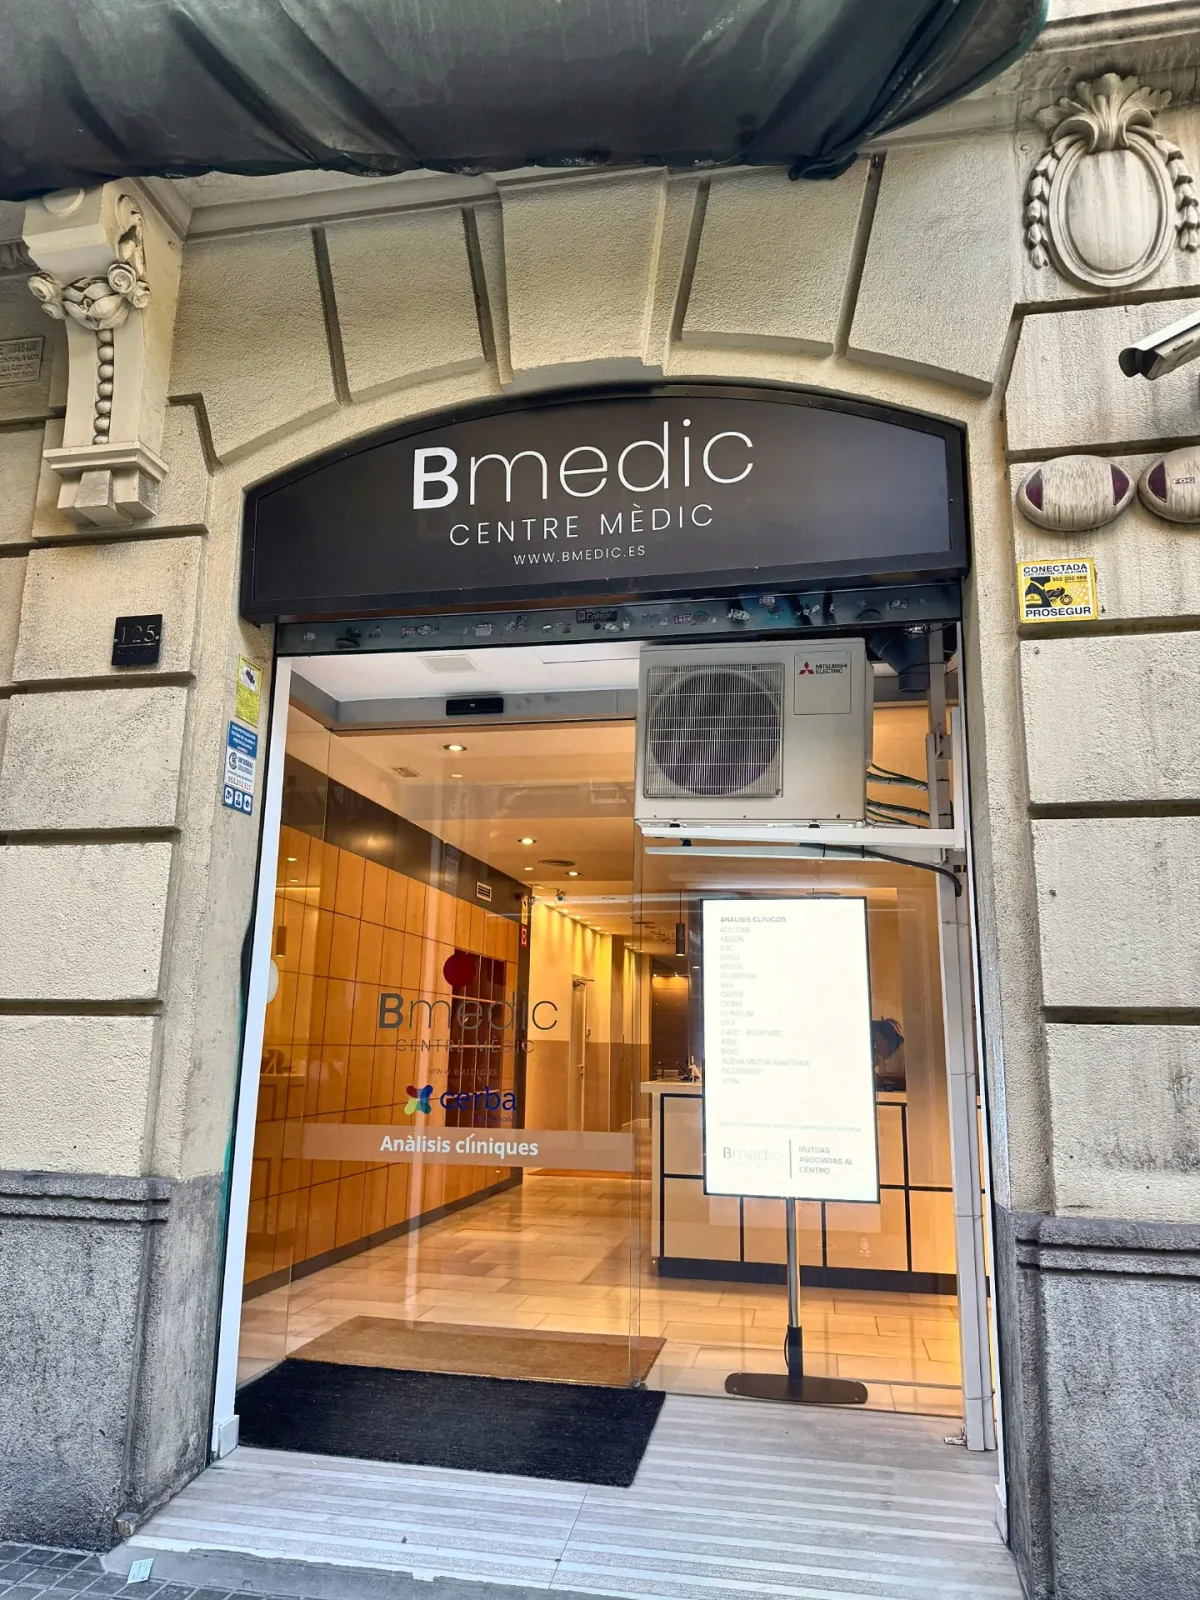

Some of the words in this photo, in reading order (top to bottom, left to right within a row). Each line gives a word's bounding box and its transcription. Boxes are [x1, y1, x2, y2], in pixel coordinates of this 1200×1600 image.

[412, 418, 754, 510] Bmedic
[449, 515, 580, 546] CENTRE
[600, 503, 714, 536] MÈDIC
[513, 544, 646, 565] WWW.BMEDIC.ES
[1023, 563, 1088, 574] CONECTADA
[1025, 606, 1092, 618] PROSEGUR
[119, 624, 156, 643] 125
[378, 990, 559, 1031] Bmedic
[395, 1038, 464, 1053] CENTRE
[476, 1036, 535, 1054] MÈDIC
[439, 1085, 517, 1111] cerba
[379, 1135, 451, 1154] Anàlisis
[455, 1133, 539, 1160] clíniques
[798, 1145, 831, 1154] MUTUAS
[798, 1155, 843, 1165] ASOCIADAS
[844, 1158, 855, 1166] AL
[798, 1166, 831, 1175] CENTRO
